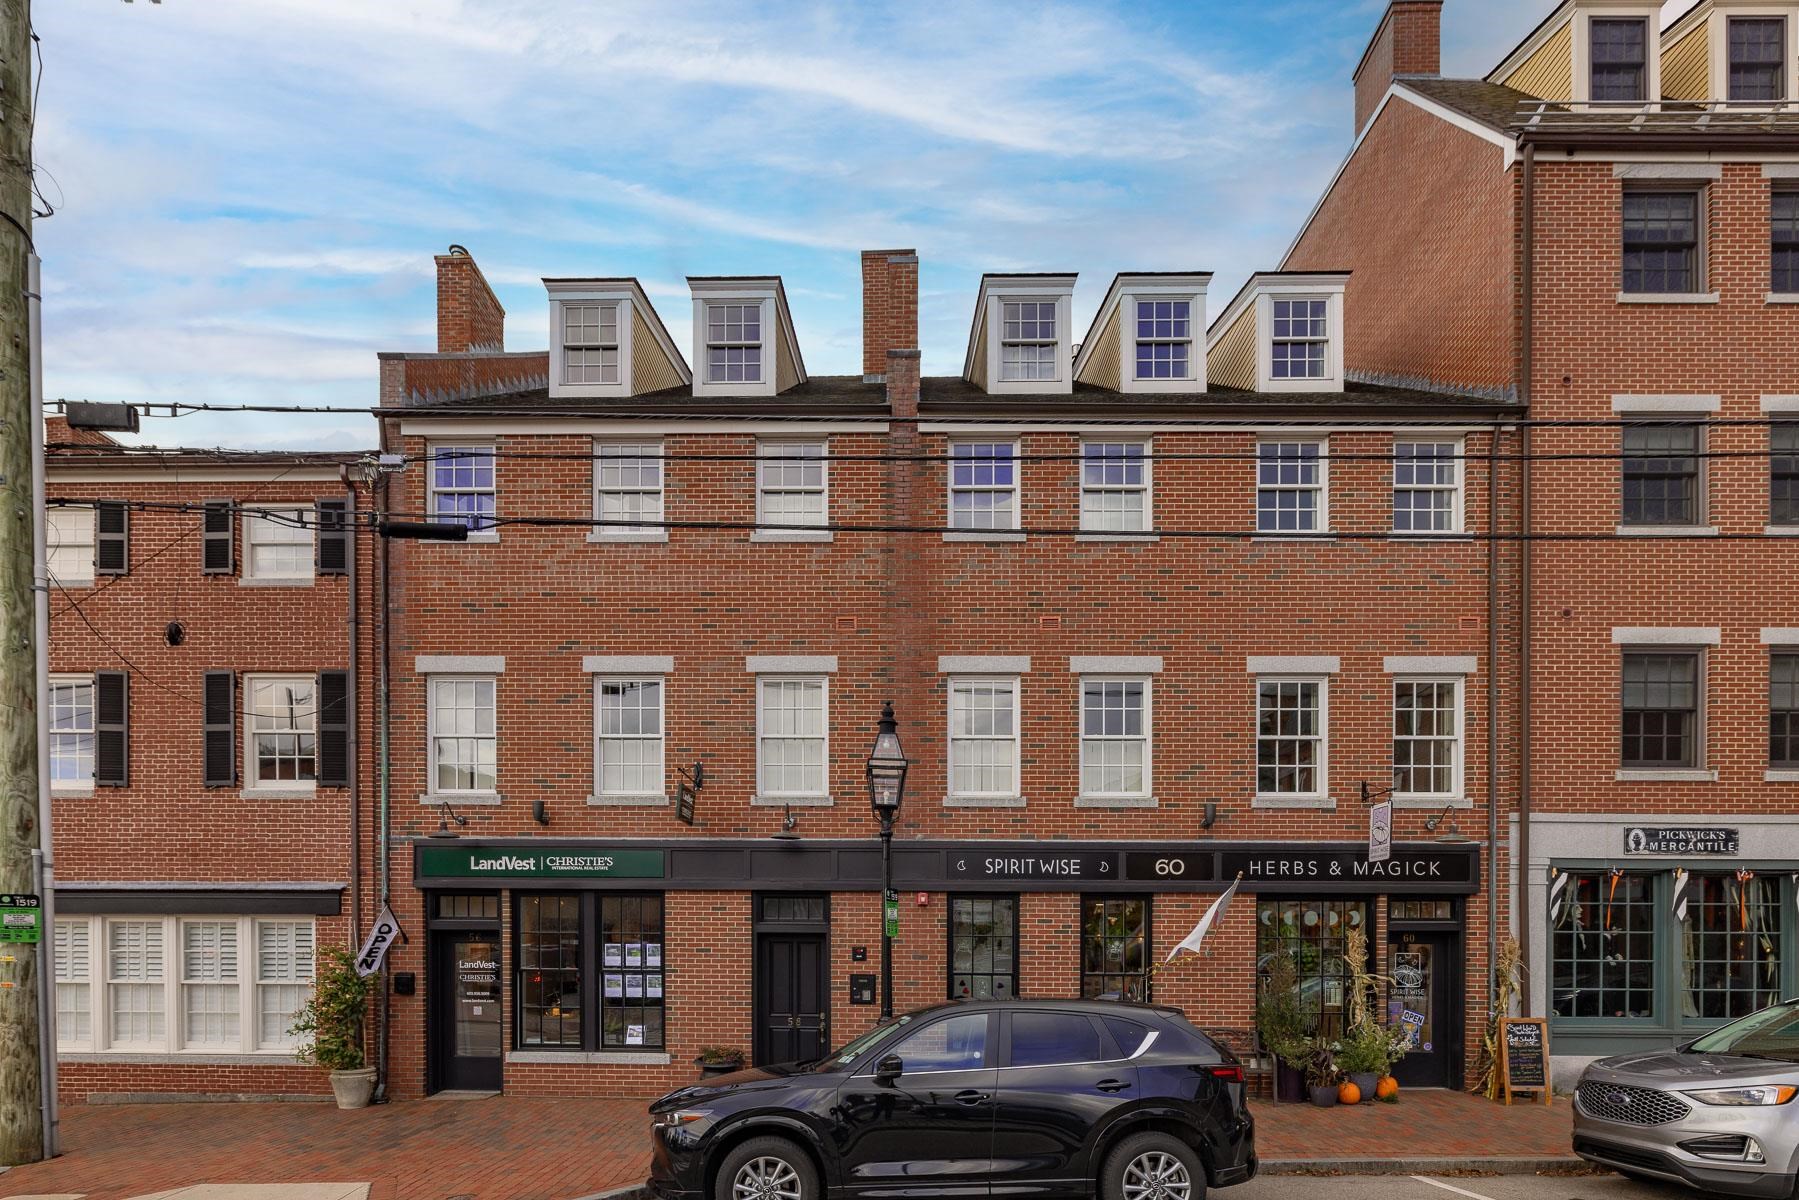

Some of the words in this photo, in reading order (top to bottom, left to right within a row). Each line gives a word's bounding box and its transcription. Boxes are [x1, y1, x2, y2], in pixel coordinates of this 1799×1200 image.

[1659, 830, 1726, 840] PICKWICK'S
[1649, 841, 1735, 851] MERCANTILE
[470, 856, 536, 871] LandVest
[546, 856, 614, 867] CHRISTIE'S
[985, 858, 1035, 874] SPIRIT
[1040, 859, 1081, 875] WISE
[1155, 858, 1185, 875] 60
[1250, 860, 1318, 875] HERBS
[1329, 860, 1342, 875] &
[1353, 860, 1441, 876] MAGICK
[15, 899, 38, 907] 1519
[1403, 934, 1415, 943] 60
[358, 923, 393, 970] OPEN
[459, 960, 496, 969] LandVest
[788, 1017, 801, 1026] 58
[1404, 1011, 1424, 1023] OPEN
